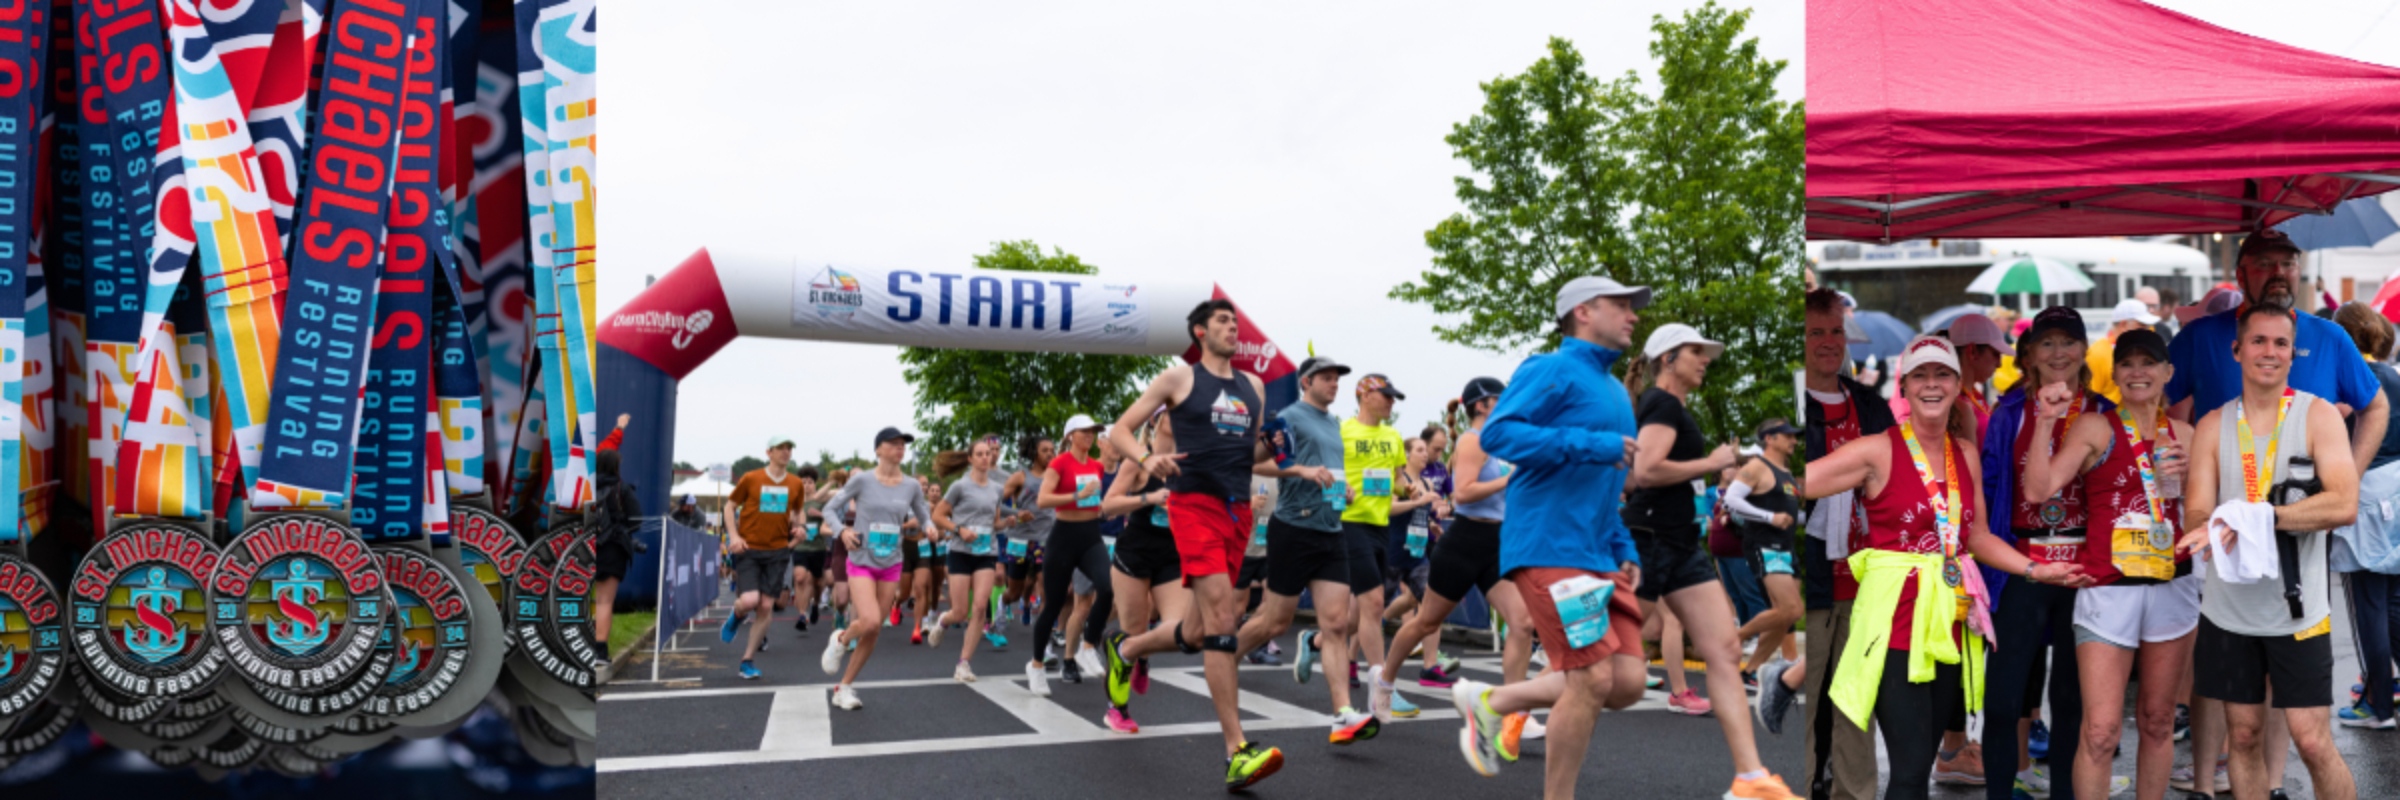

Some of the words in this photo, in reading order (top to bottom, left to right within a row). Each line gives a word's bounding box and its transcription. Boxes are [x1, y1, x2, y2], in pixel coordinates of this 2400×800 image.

[887, 270, 1081, 331] START
[2045, 545, 2077, 561] 2327
[76, 607, 96, 623] 20
[216, 602, 238, 620] 20
[358, 601, 380, 618] 24
[518, 601, 538, 617] 20
[560, 603, 580, 618] 20
[40, 633, 60, 647] 24
[445, 630, 466, 643] 24
